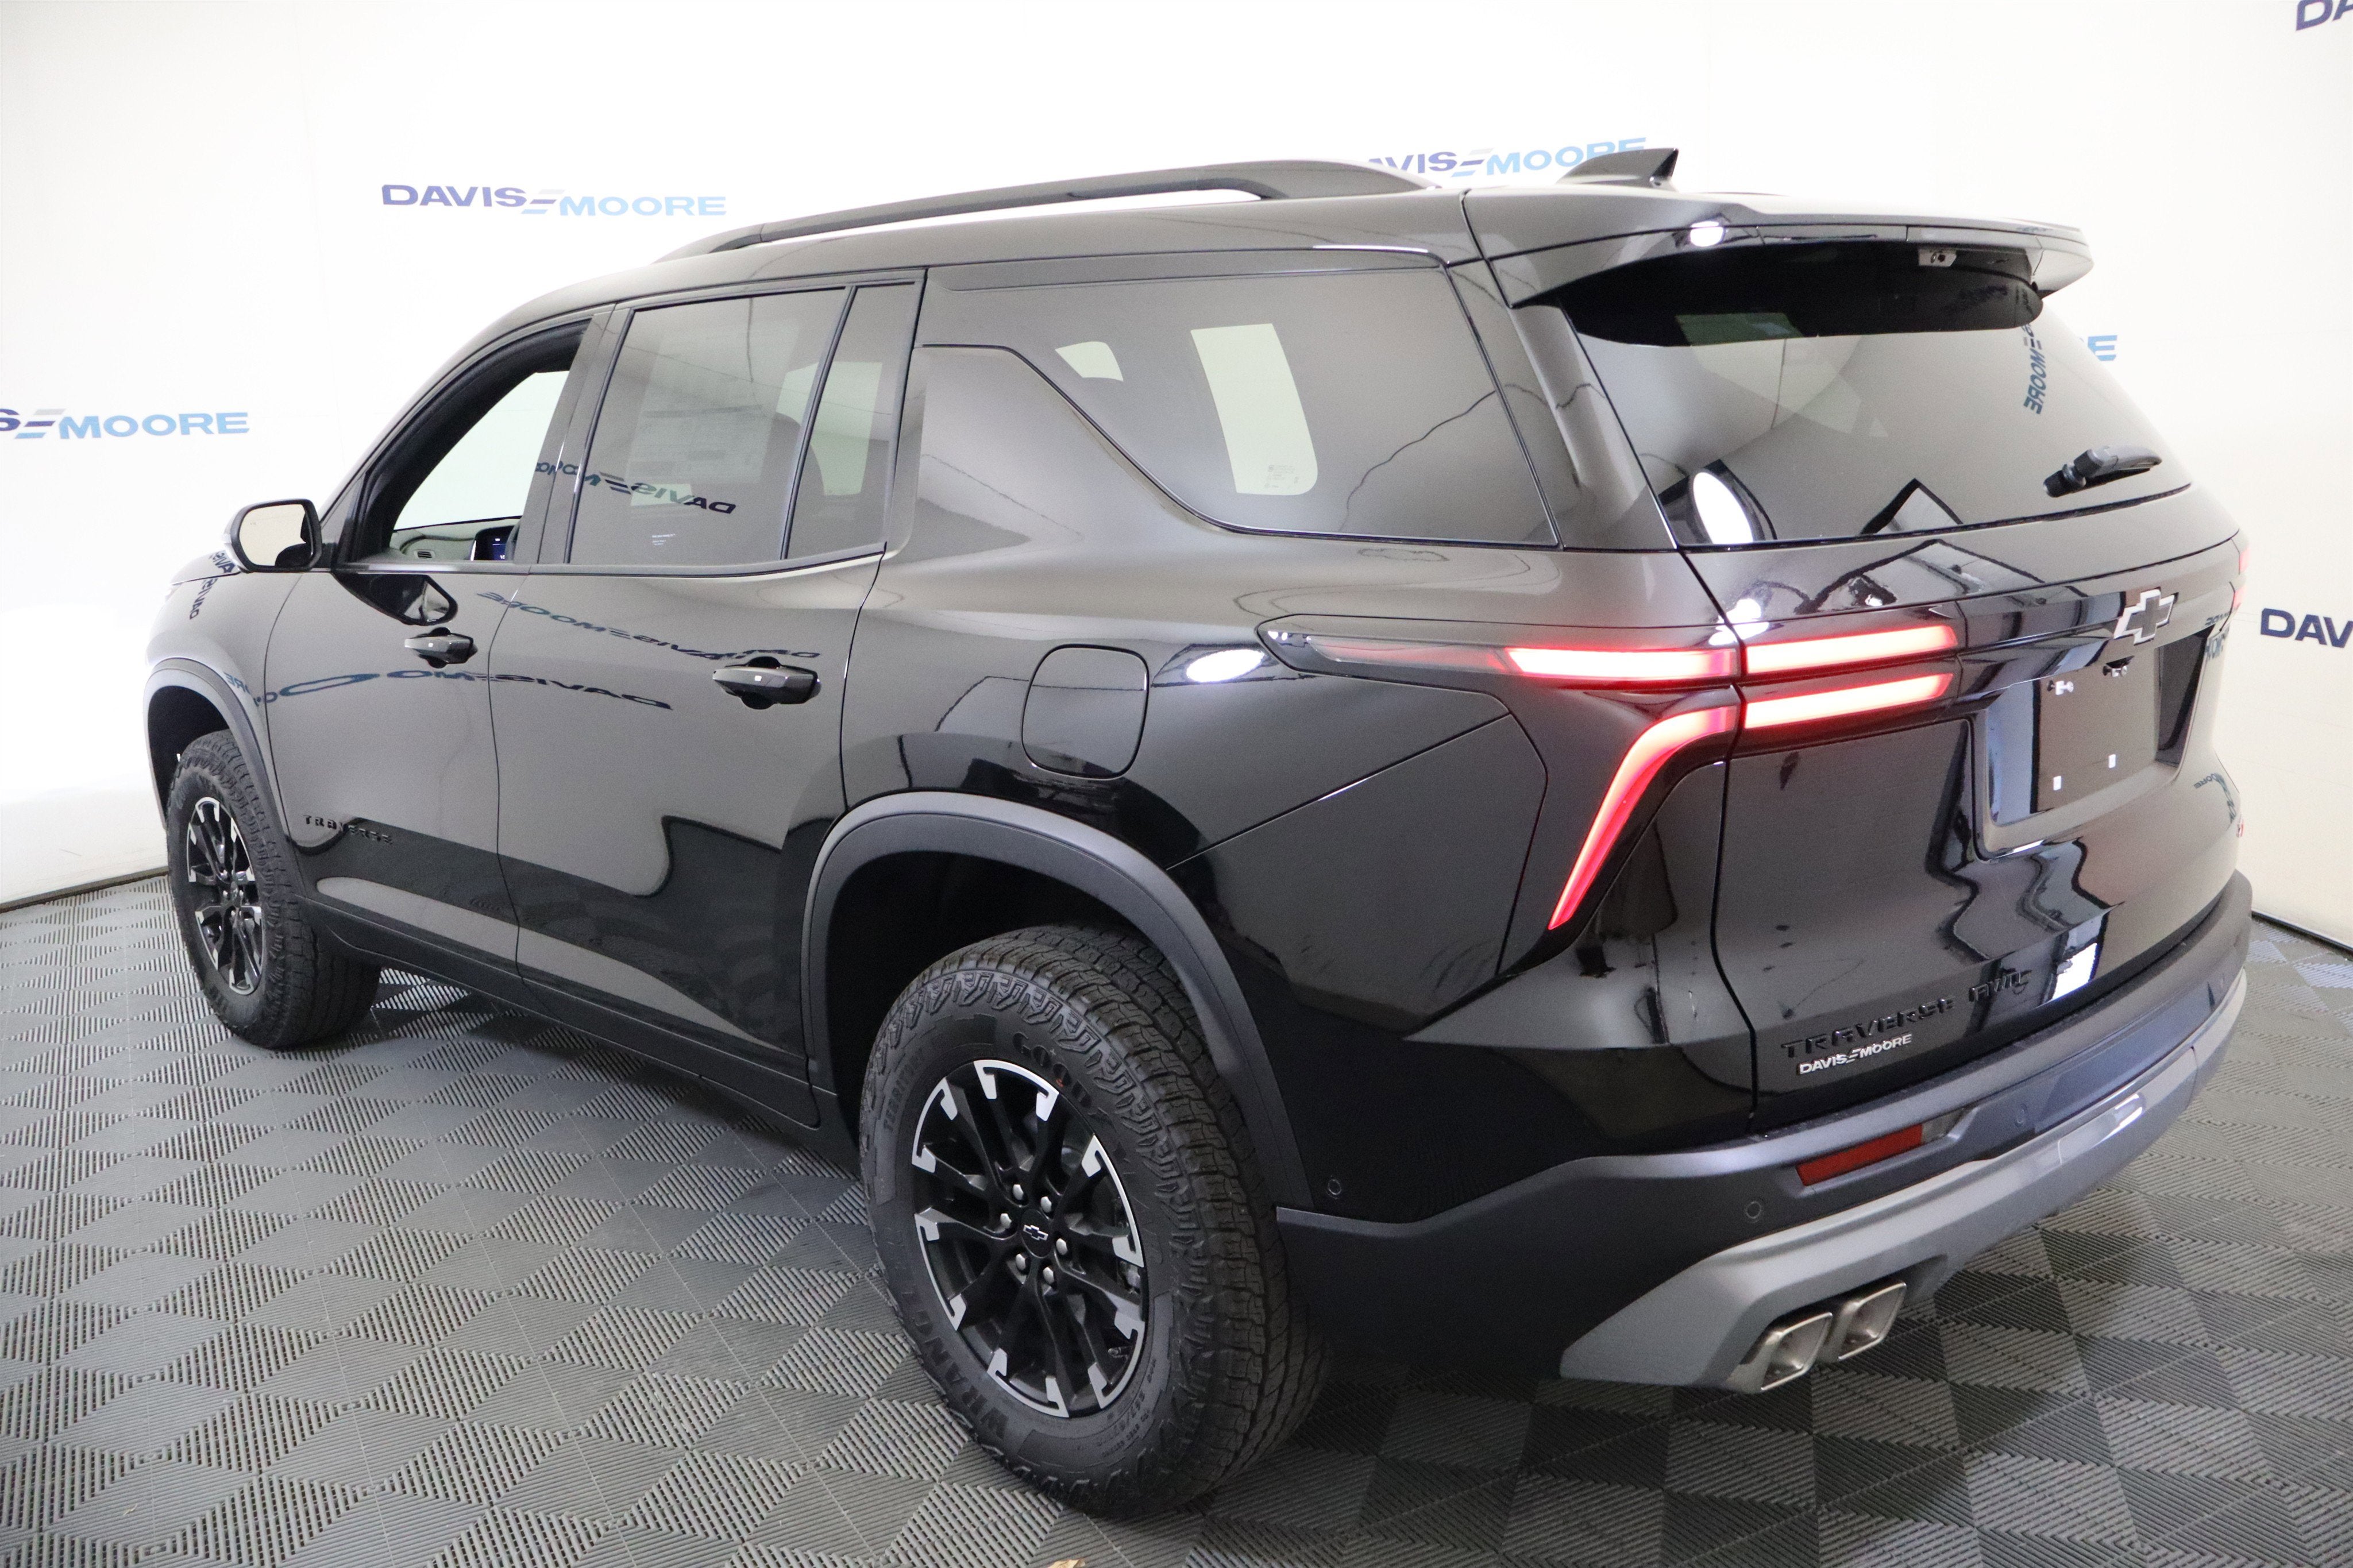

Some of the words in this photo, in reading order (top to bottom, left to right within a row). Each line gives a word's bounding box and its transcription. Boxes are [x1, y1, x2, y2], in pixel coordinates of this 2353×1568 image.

[381, 184, 527, 207] DAVIS
[559, 196, 727, 217] MOORE
[59, 412, 250, 439] MOORE
[1781, 996, 1954, 1058] TRAVERSE
[1799, 1054, 1848, 1075] DAVIS
[1859, 1034, 1912, 1059] MOORE
